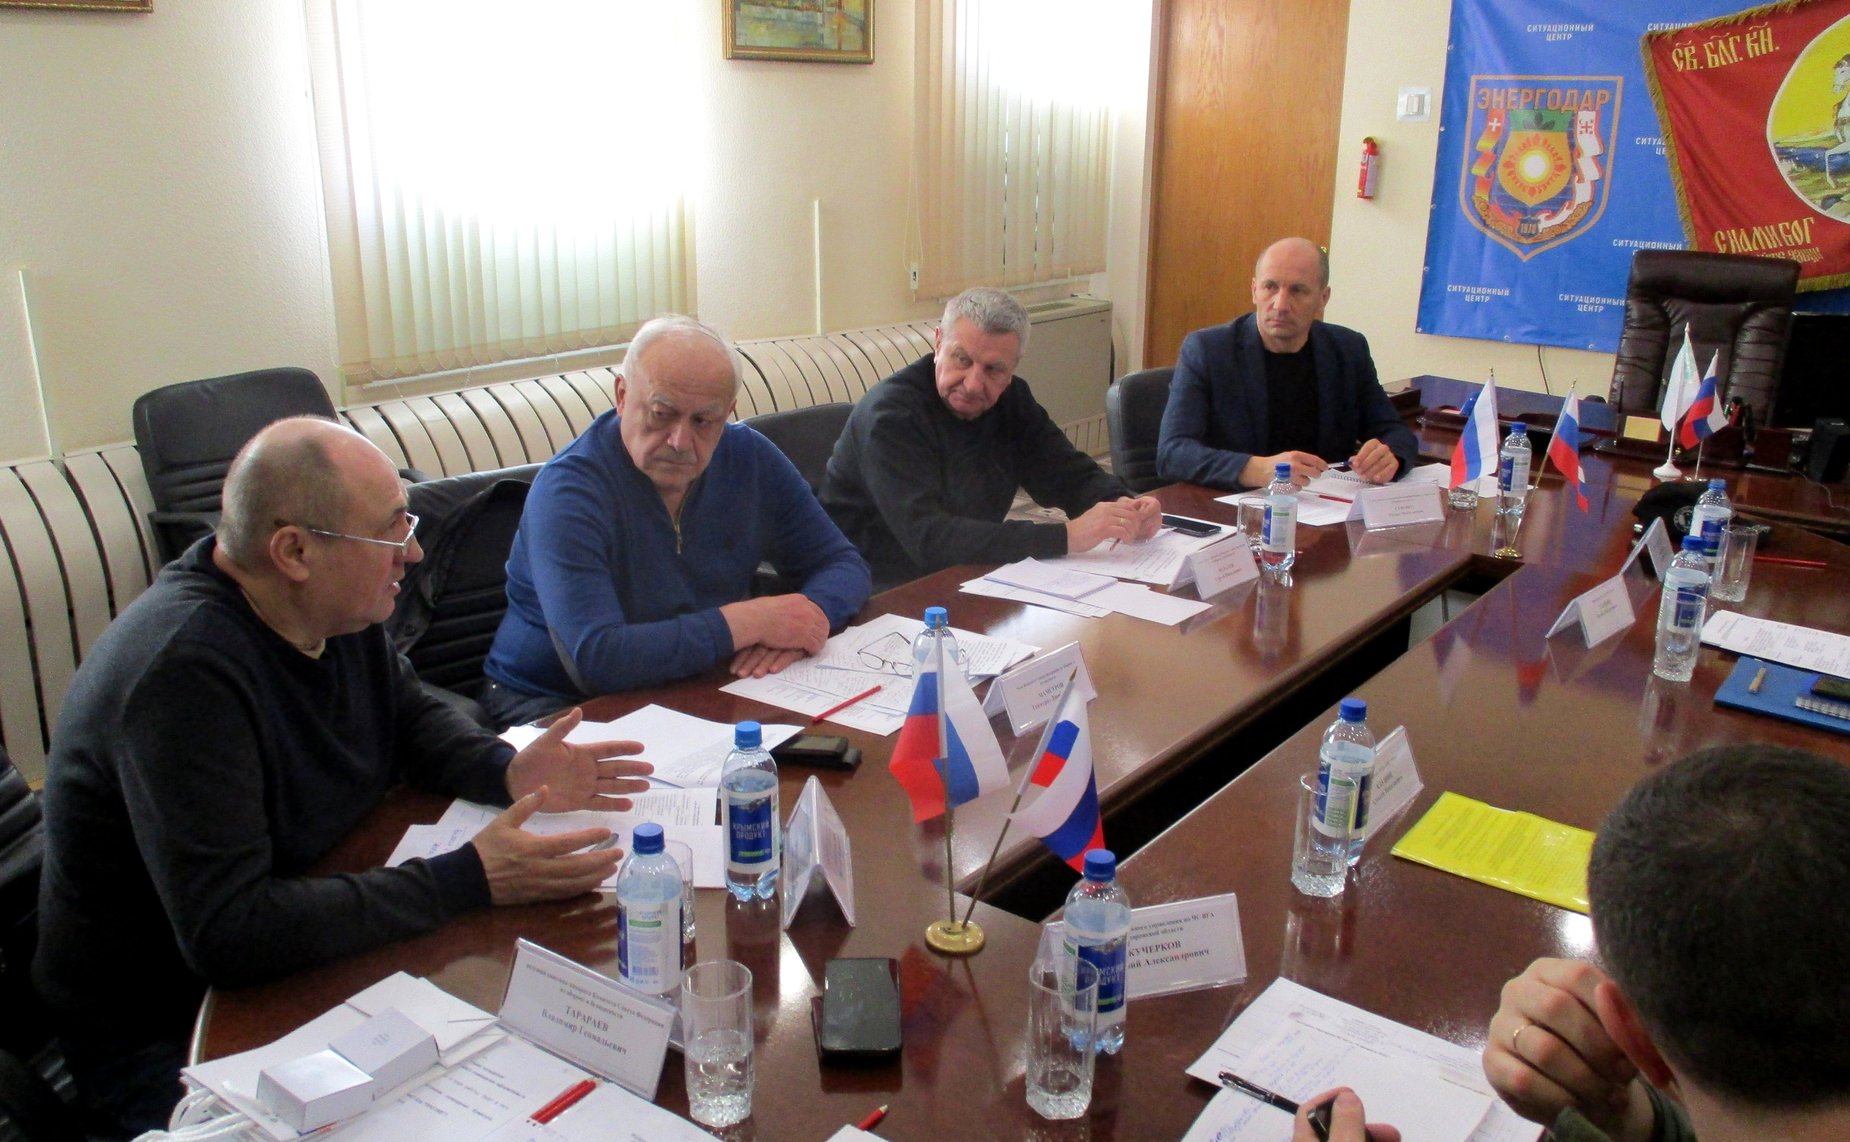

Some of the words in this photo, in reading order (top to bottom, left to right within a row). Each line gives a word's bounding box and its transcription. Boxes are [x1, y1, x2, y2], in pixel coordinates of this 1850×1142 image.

[1526, 24, 1594, 33] СИТУАЦИОННЫЙ
[1545, 33, 1573, 42] ЦЕНТР
[1477, 87, 1610, 113] ЭНЕРГОДАР
[1612, 239, 1683, 251] СИТУАЦИОННЫЙ
[1447, 284, 1510, 296] СИТУАЦИОННЫЙ
[1465, 294, 1490, 303] ЦЕНТР
[1558, 293, 1625, 306] СИТУАЦИОННЫЙ
[1577, 303, 1604, 312] ЦЕНТР
[1128, 940, 1182, 957] КУЧЕРКОВ
